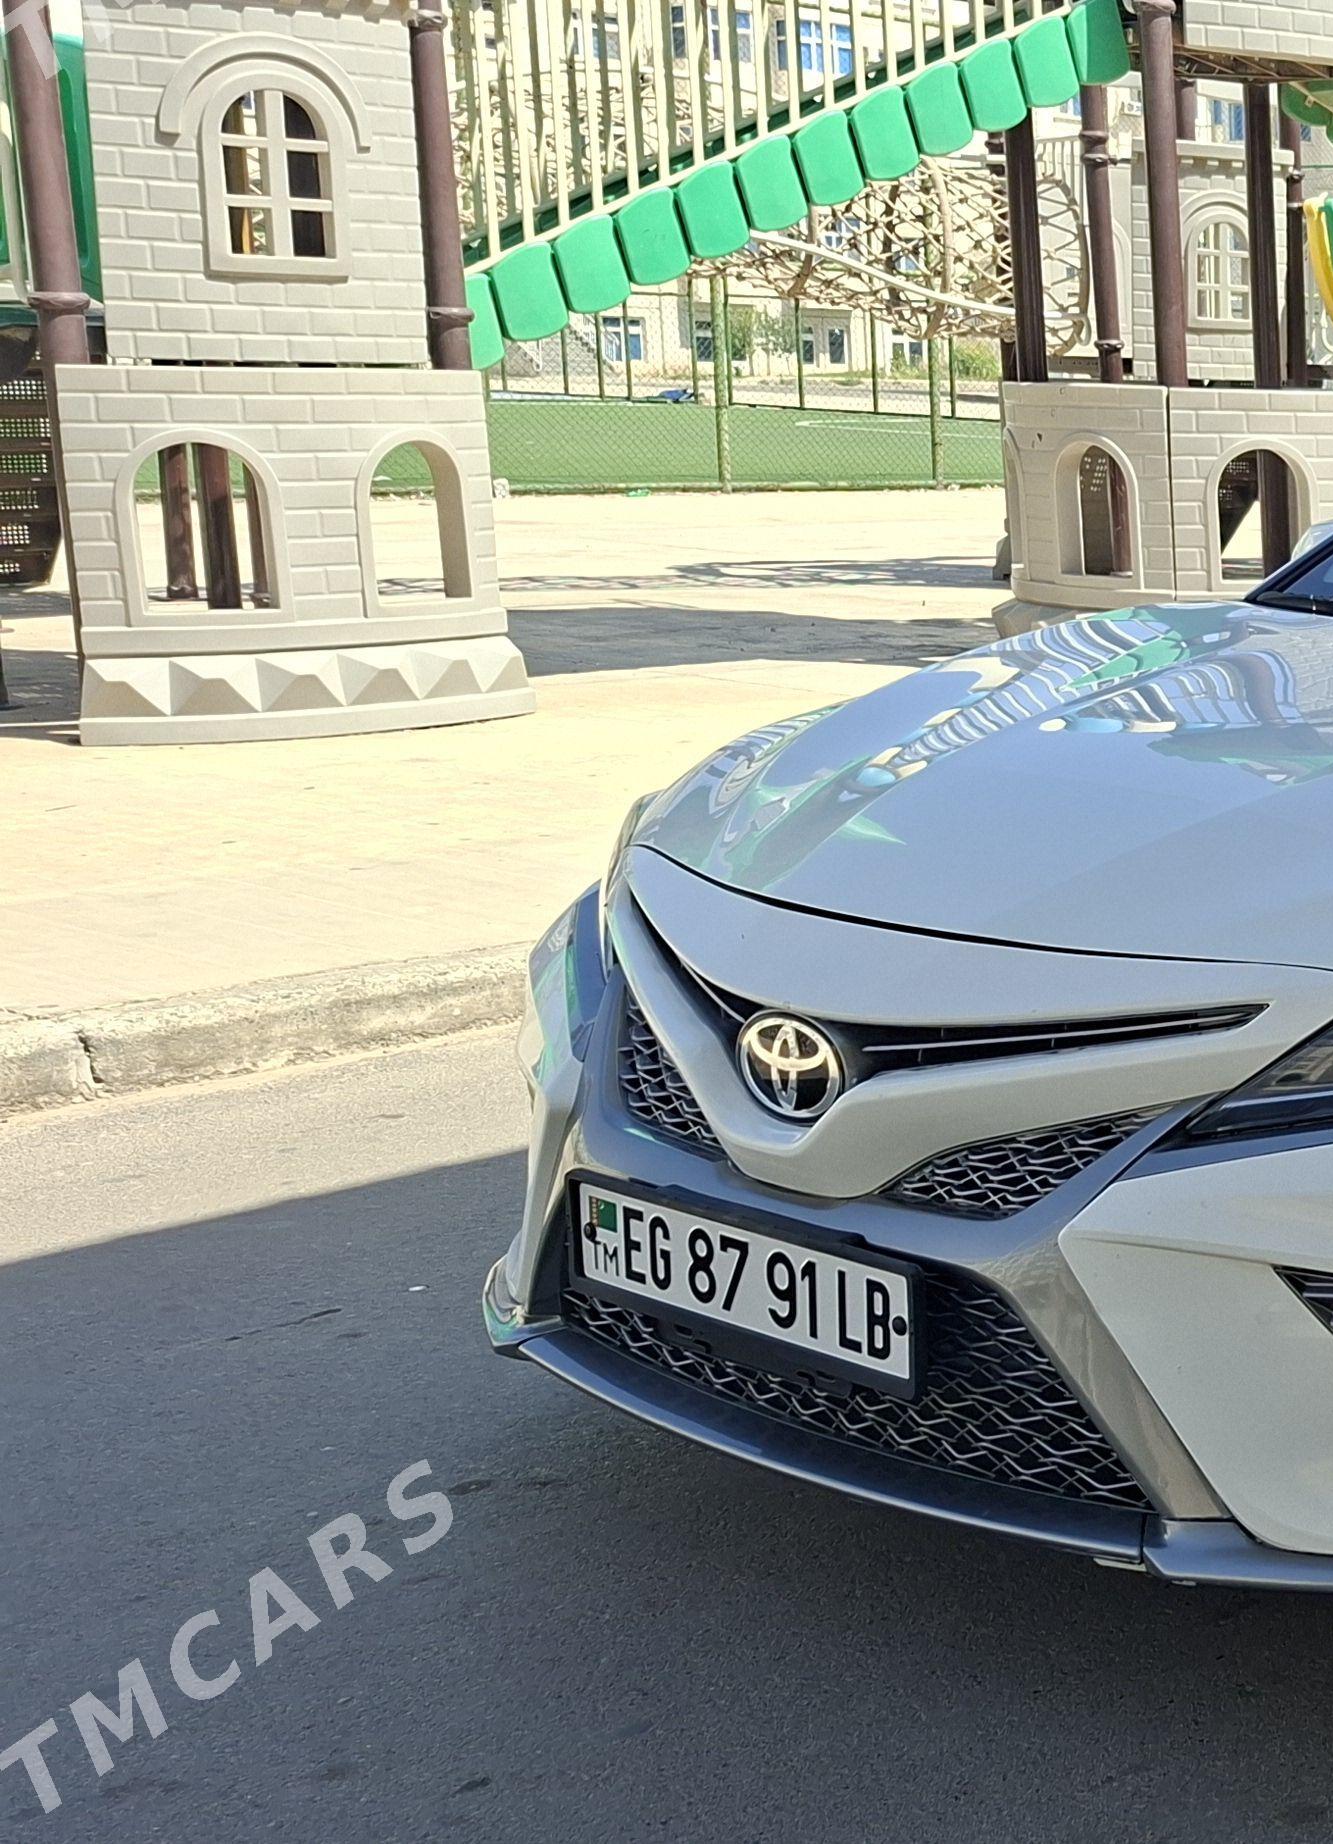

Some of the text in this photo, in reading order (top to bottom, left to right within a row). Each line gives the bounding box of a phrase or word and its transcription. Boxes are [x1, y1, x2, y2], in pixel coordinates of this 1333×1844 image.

[590, 1239, 619, 1277] TM
[623, 1205, 890, 1360] EG 87 91 LB
